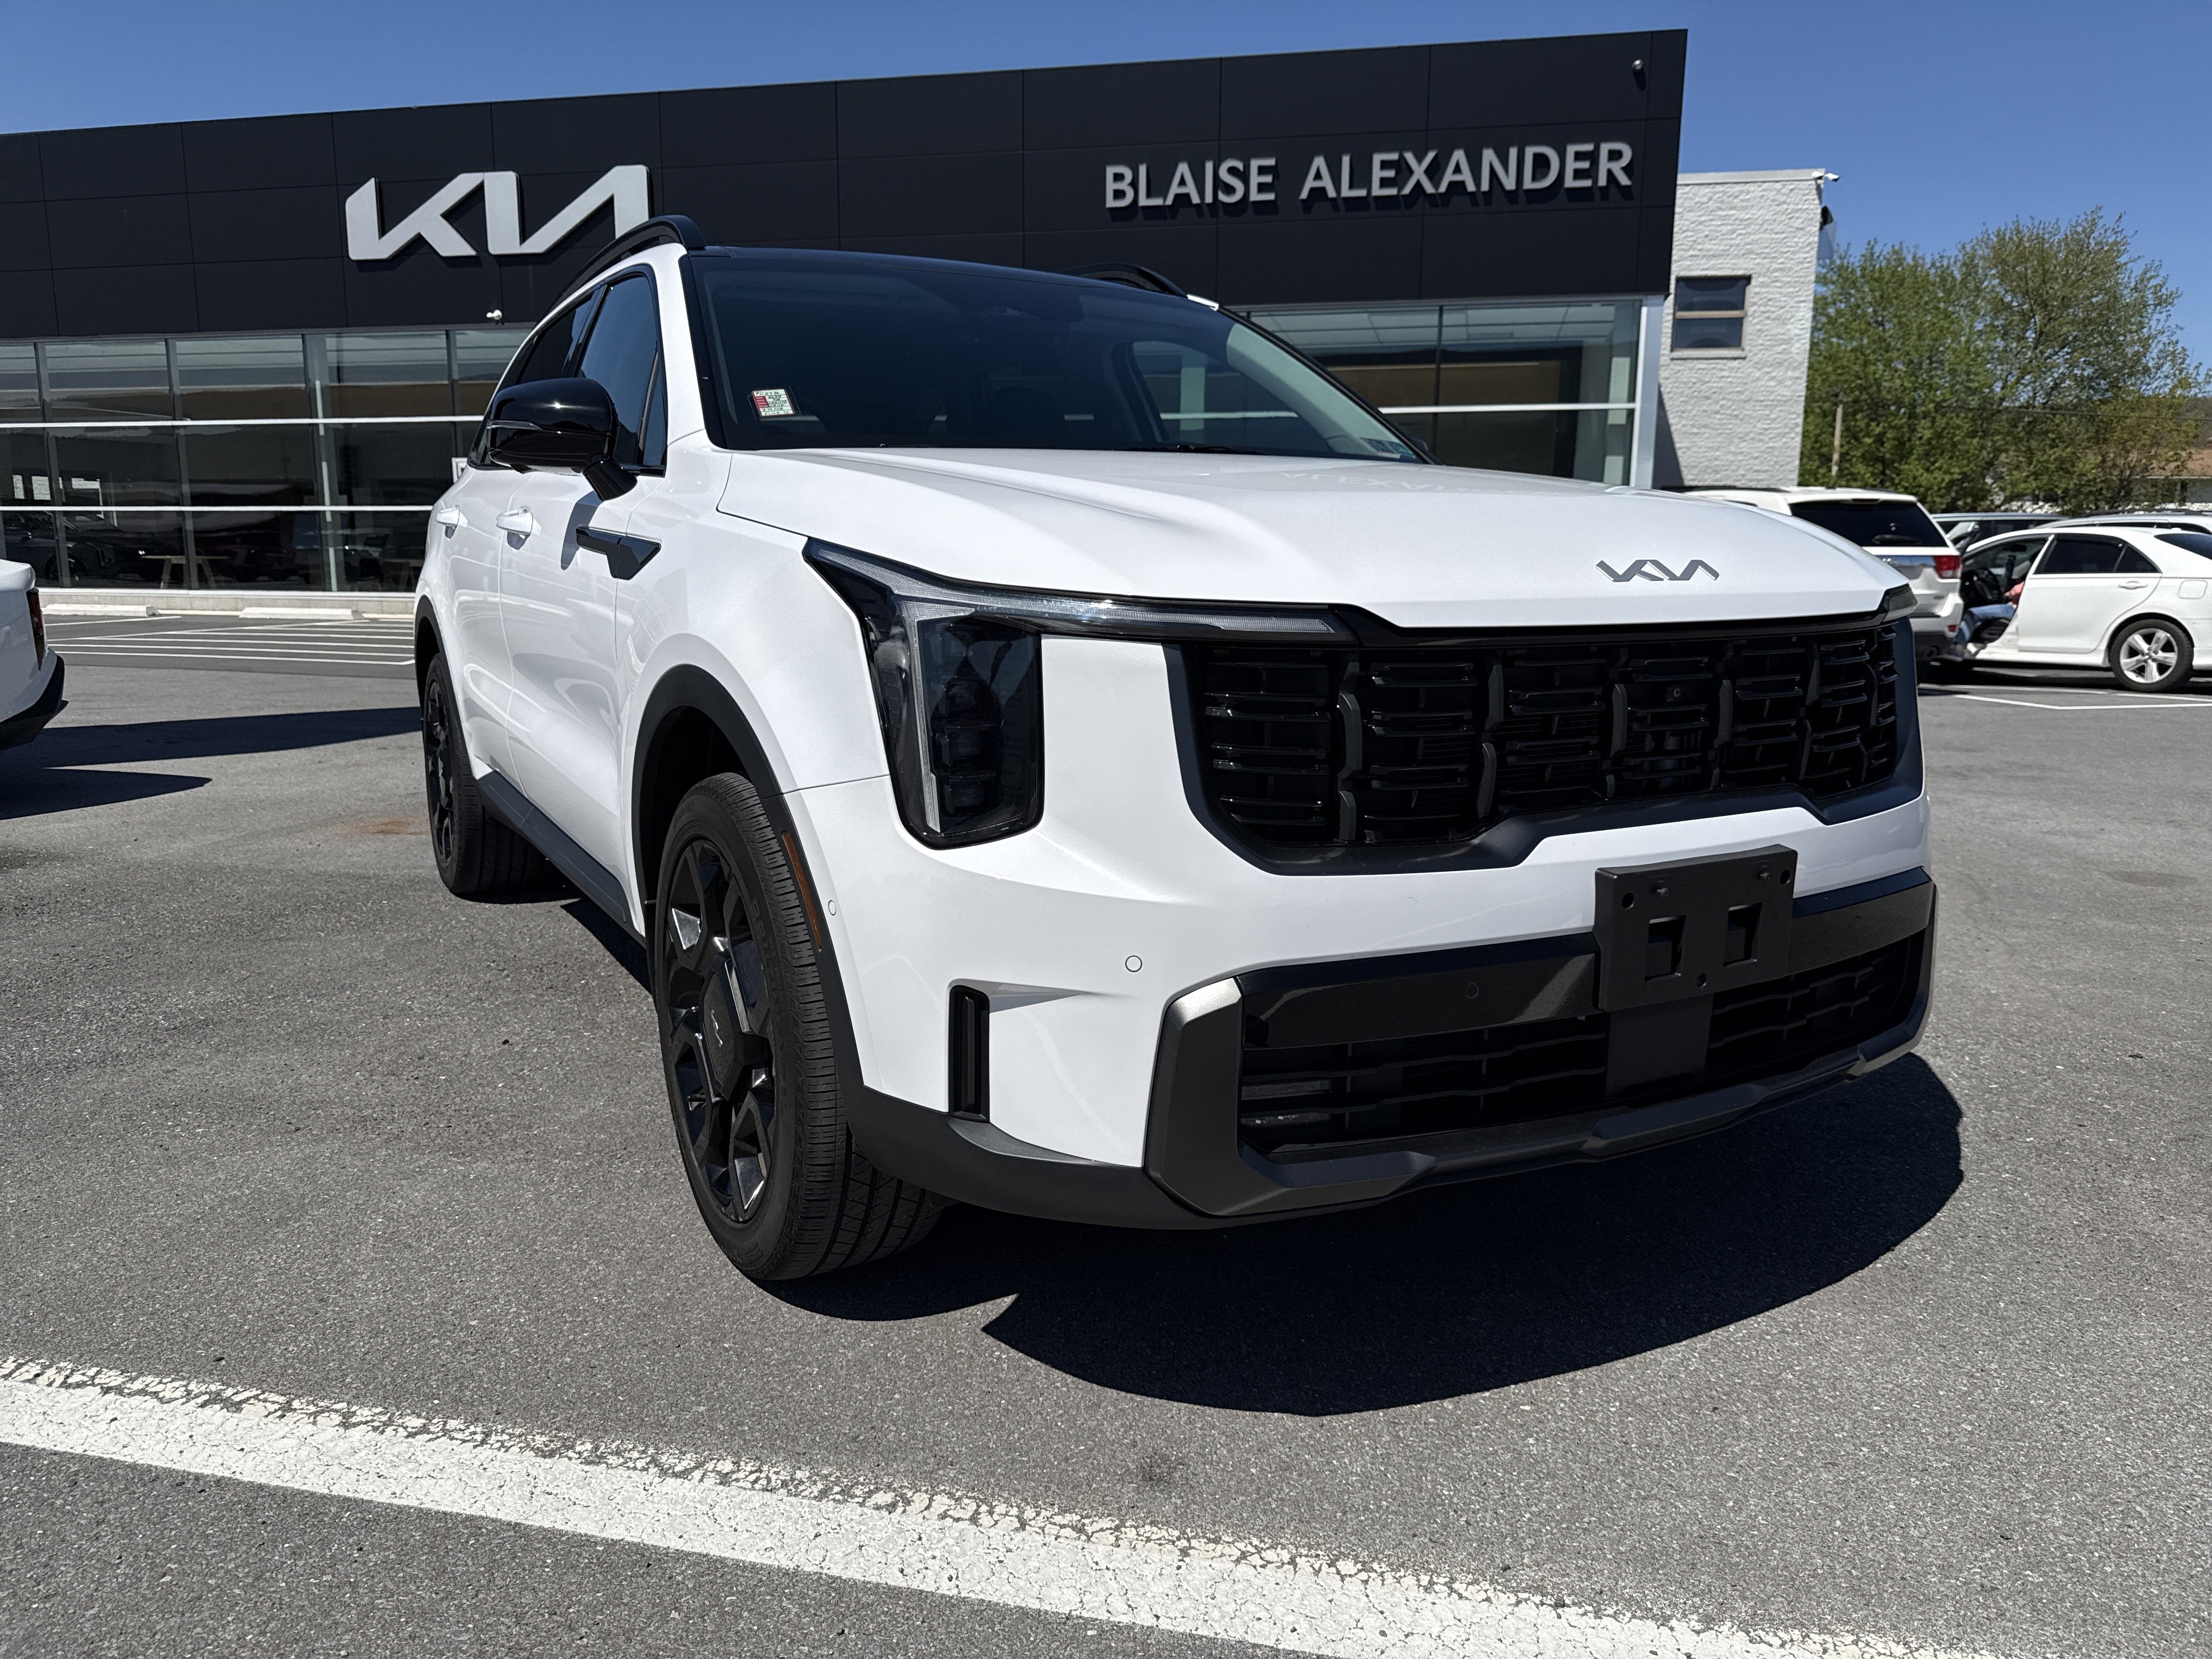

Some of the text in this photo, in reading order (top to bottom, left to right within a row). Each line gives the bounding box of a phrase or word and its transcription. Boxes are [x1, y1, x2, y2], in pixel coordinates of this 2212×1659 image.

[1104, 140, 1633, 208] BLAISE ALEXANDER
[345, 164, 650, 260] KIA
[1596, 560, 1719, 582] KIA
